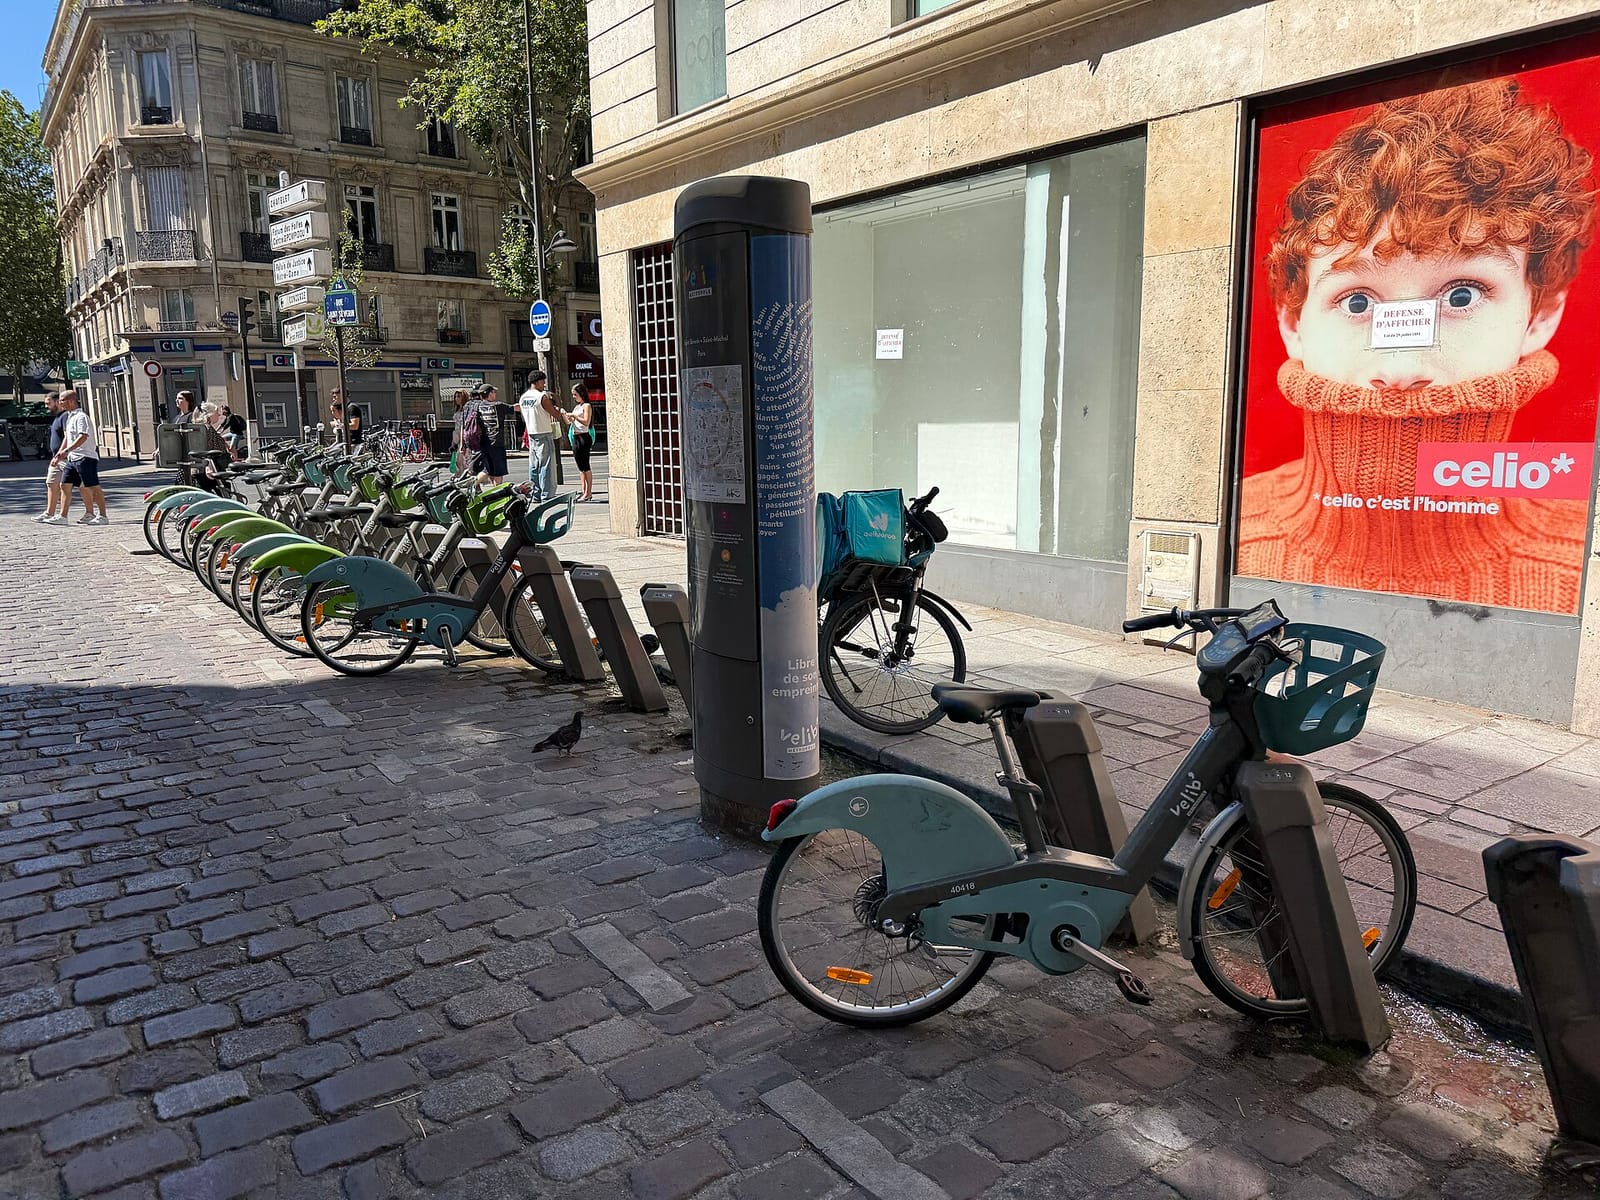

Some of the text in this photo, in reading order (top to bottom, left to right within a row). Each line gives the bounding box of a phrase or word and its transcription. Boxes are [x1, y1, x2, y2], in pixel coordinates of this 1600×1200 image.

[1376, 318, 1431, 329] D'AFFICHER
[162, 341, 184, 351] CIC
[575, 362, 593, 370] CHANGE
[764, 365, 792, 382] vivants
[766, 364, 804, 392] rayonnants
[766, 395, 800, 412] attentifs
[1366, 494, 1410, 511] c'est
[1413, 496, 1500, 515] l'homme
[769, 508, 806, 519] pétillants
[783, 673, 800, 684] de
[950, 882, 976, 894] 40418
